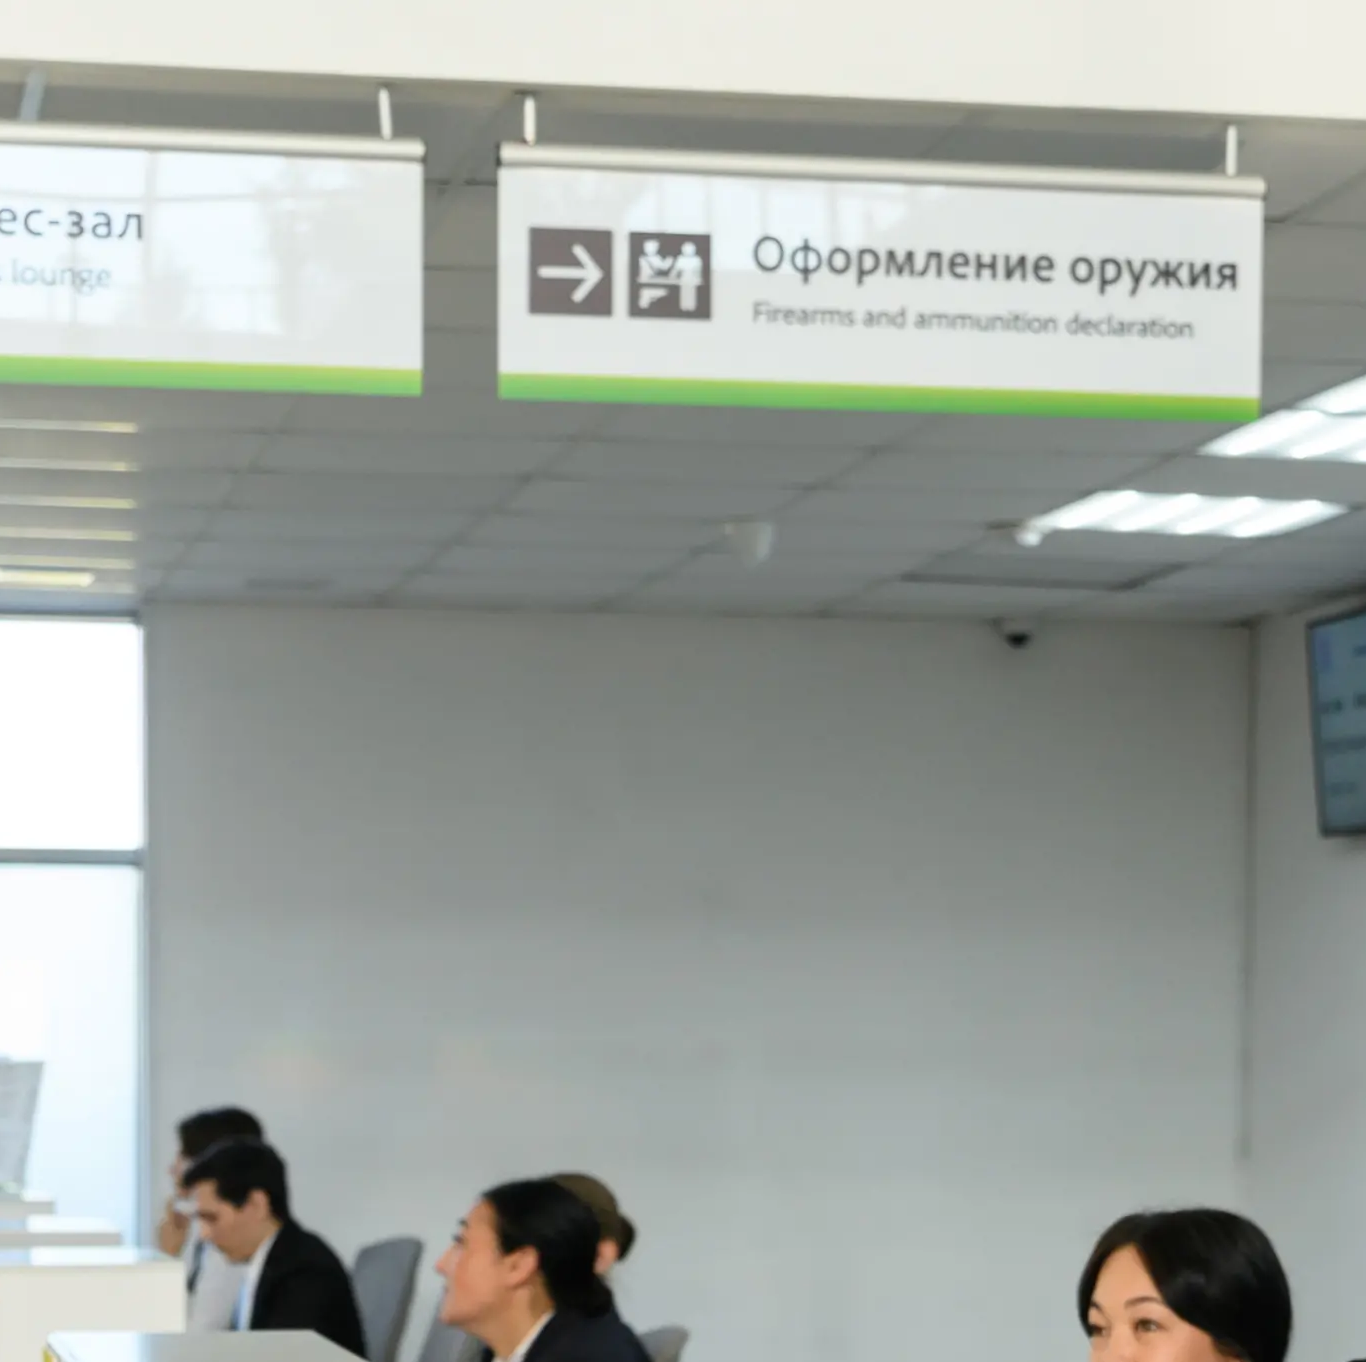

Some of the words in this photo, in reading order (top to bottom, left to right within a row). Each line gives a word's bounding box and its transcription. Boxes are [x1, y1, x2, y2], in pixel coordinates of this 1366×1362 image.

[11, 256, 113, 294] lounge
[752, 234, 1056, 288] Оформление
[1069, 255, 1239, 295] оружия
[752, 301, 857, 329] Firearms
[863, 304, 907, 330] and
[913, 308, 1059, 336] ammunition
[1065, 313, 1196, 341] declaration
